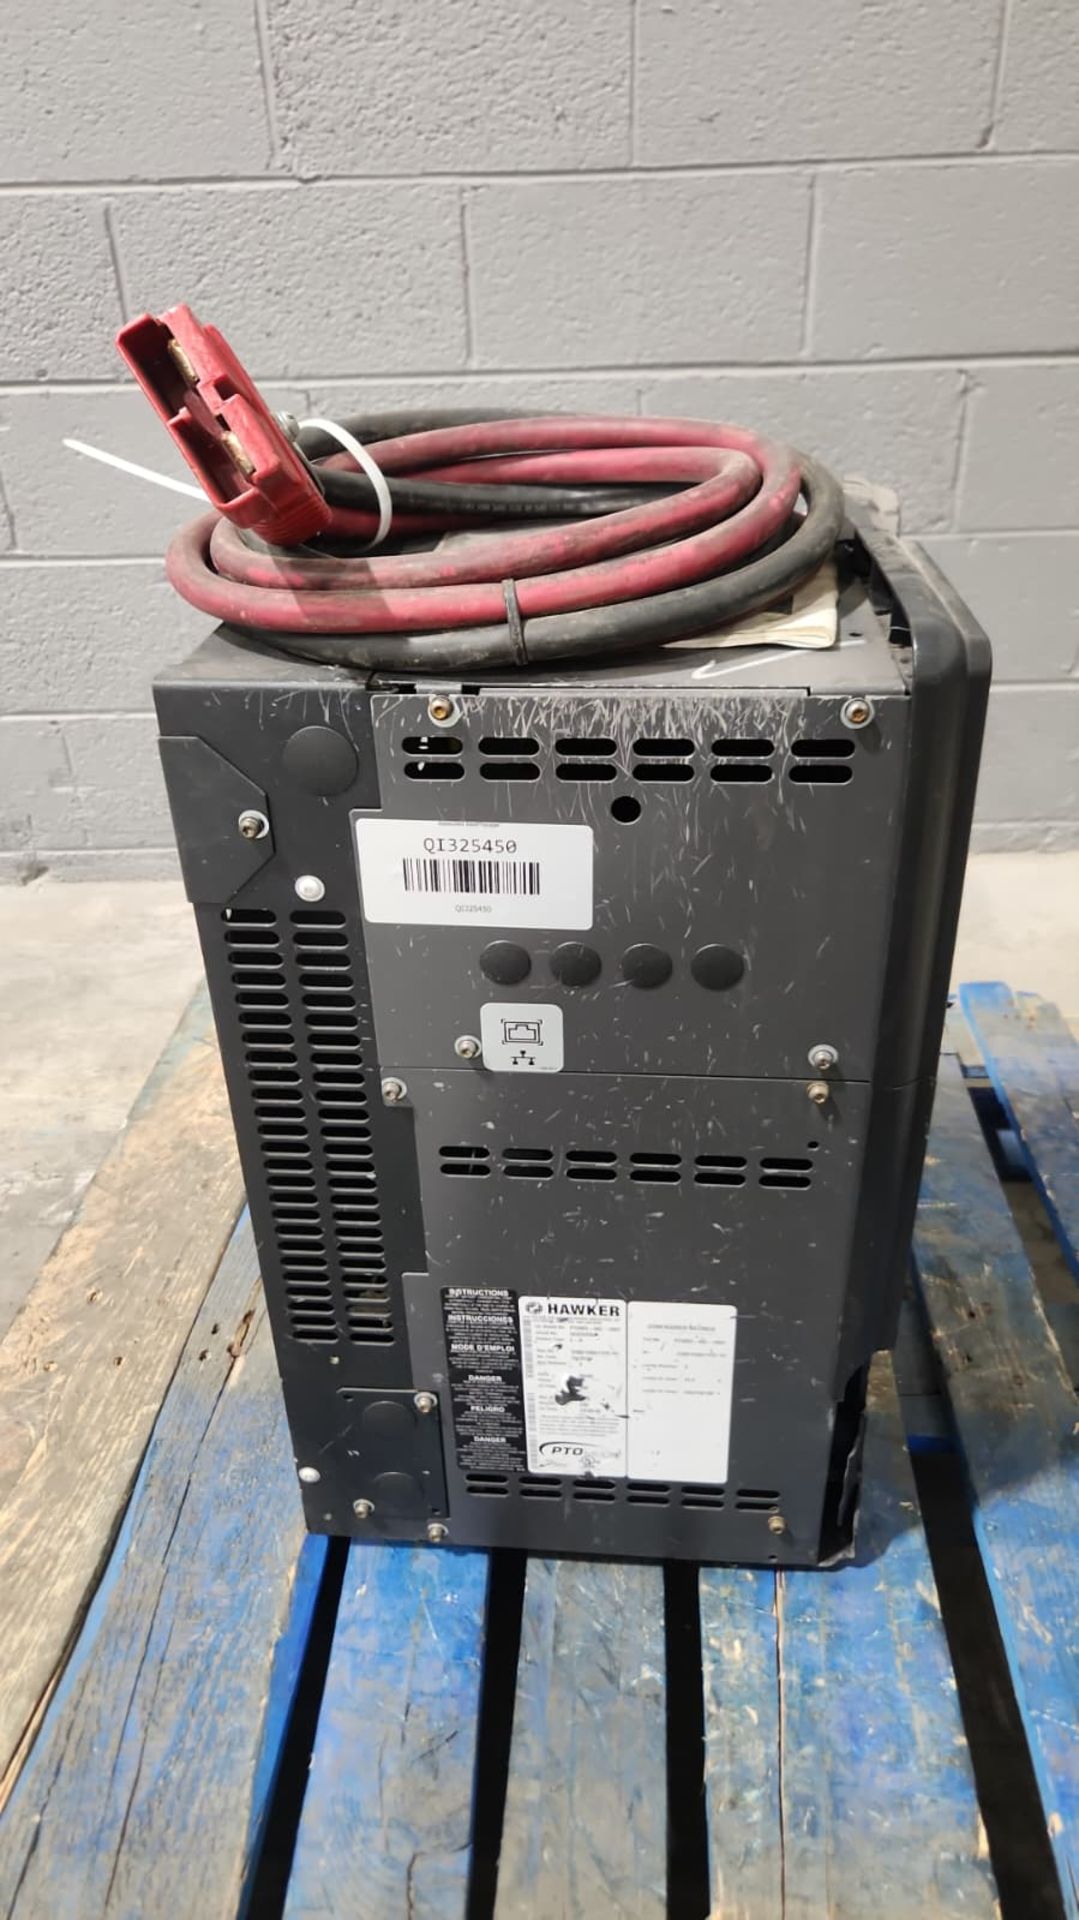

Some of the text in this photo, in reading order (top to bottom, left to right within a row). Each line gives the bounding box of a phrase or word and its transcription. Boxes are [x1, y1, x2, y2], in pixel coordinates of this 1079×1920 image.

[423, 837, 518, 854] QI325450
[547, 1303, 620, 1317] HAWKER
[450, 1343, 475, 1351] MODE
[468, 1374, 502, 1382] DANGER
[470, 1405, 505, 1413] PELIGRO
[552, 1446, 584, 1456] PTO
